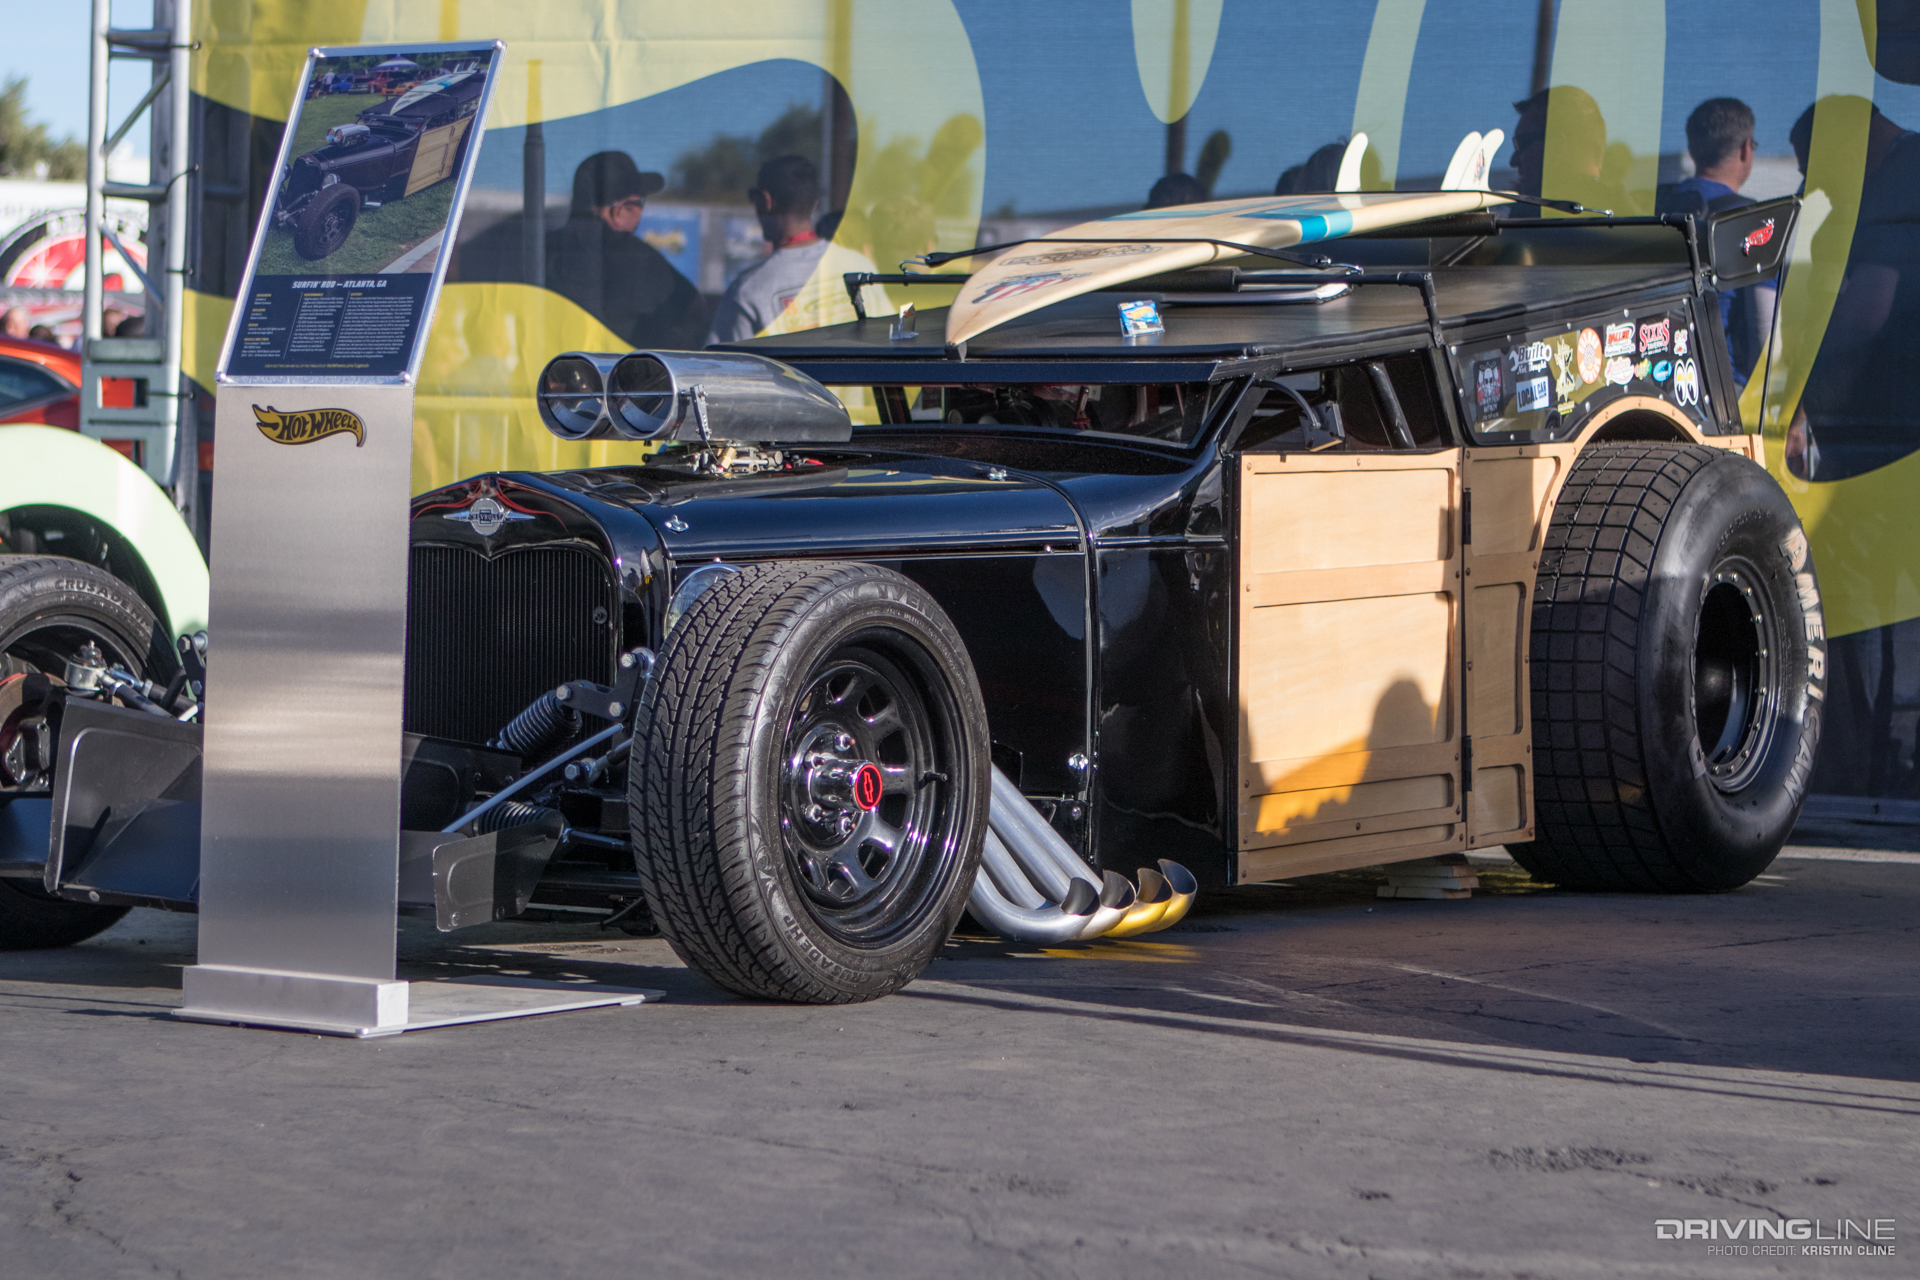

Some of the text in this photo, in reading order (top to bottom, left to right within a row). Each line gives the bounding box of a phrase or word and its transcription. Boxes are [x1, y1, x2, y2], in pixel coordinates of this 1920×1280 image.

[292, 280, 321, 289] SURFIN'
[321, 280, 337, 289] ROD
[343, 280, 375, 289] ATLANTA,
[376, 280, 387, 288] GA
[1640, 318, 1670, 352] SIXES
[1519, 342, 1545, 360] Built
[1518, 385, 1538, 408] LOCAL
[1778, 527, 1826, 810] AMERICAN
